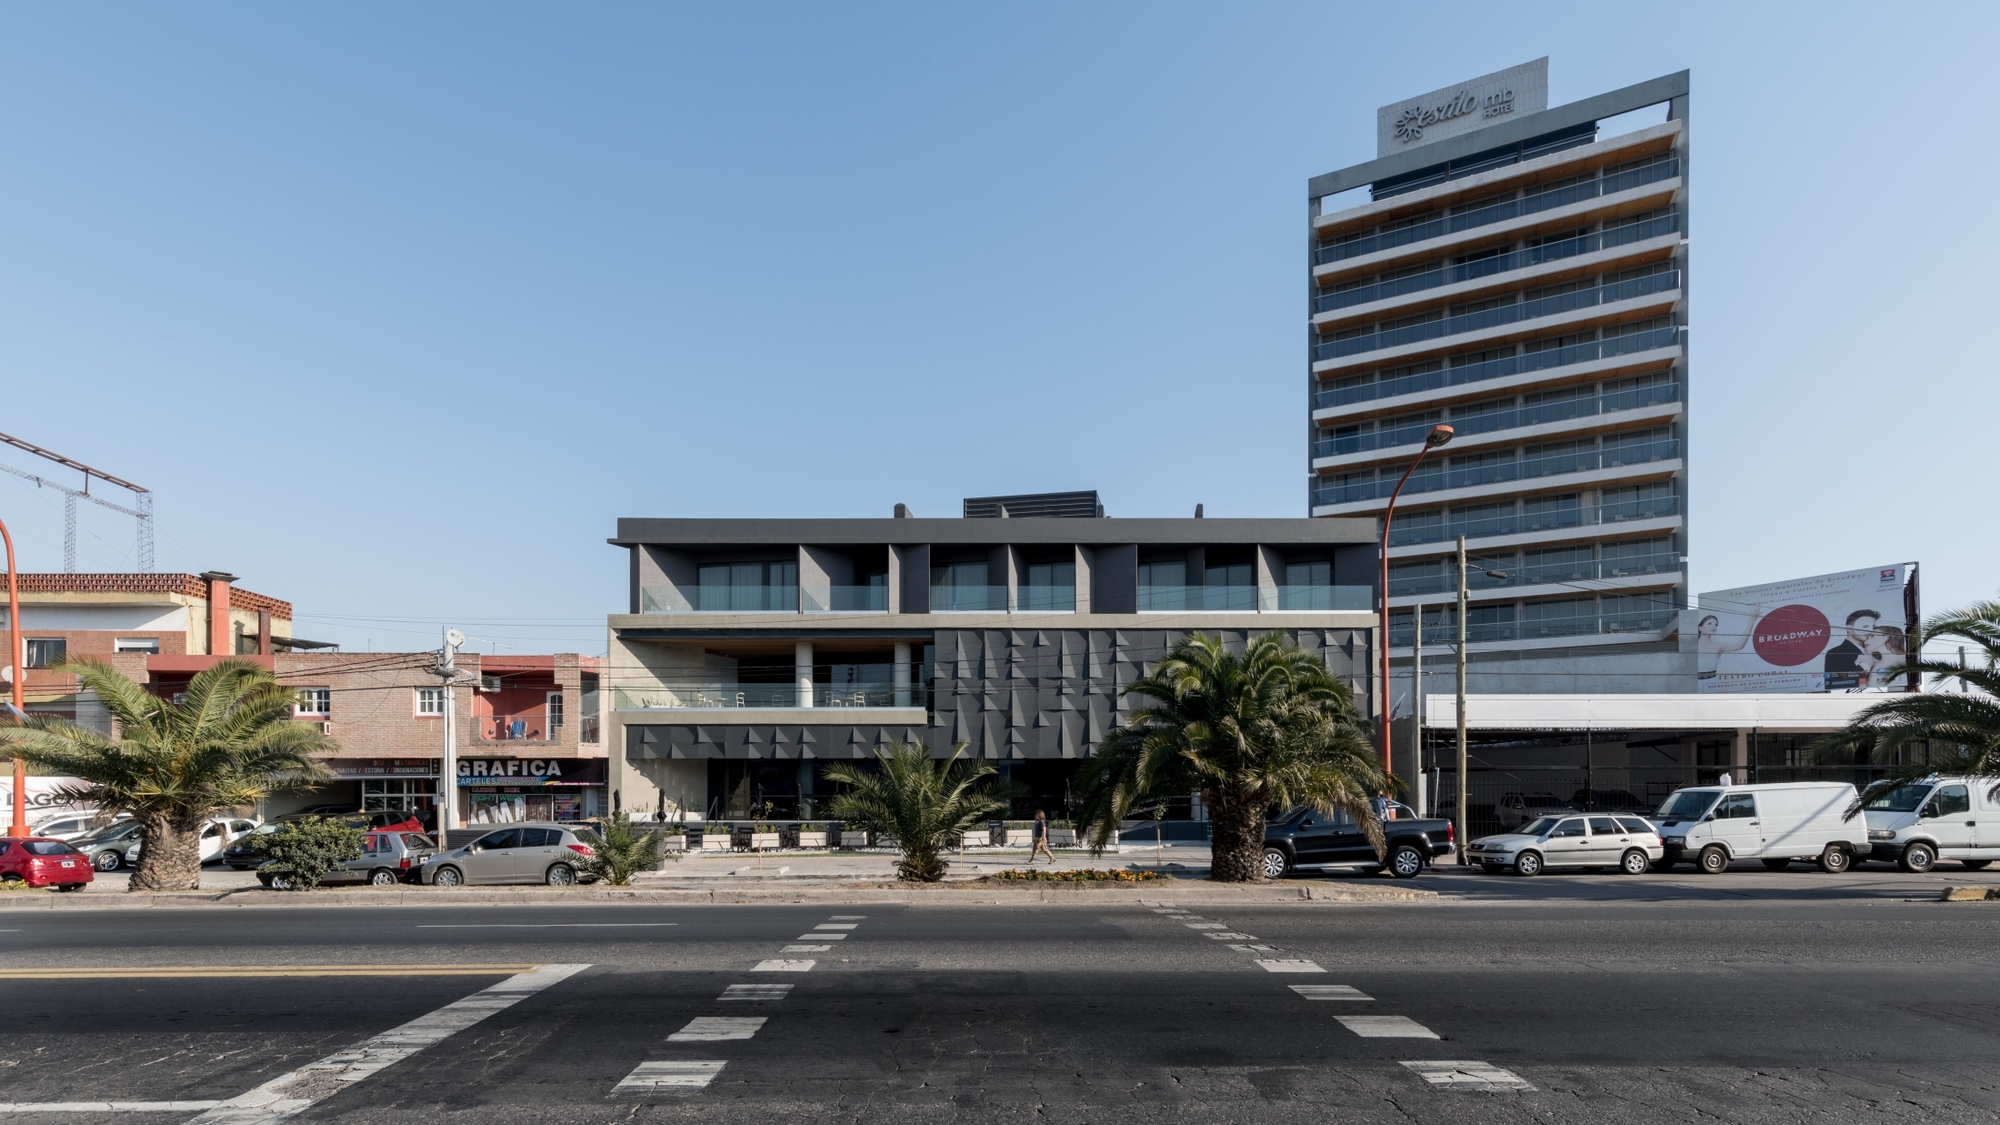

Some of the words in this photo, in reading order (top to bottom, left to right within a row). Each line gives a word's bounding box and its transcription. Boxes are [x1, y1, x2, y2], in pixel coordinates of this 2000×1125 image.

[1417, 90, 1478, 127] estilo
[1483, 103, 1515, 120] HOTEL
[1744, 587, 1772, 595] mejores
[1775, 580, 1812, 590] musicales
[1827, 573, 1867, 582] Broadway
[1792, 585, 1817, 593] Carlos
[1758, 629, 1823, 643] BROADWAY
[457, 760, 562, 776] GRAFICA
[457, 777, 497, 785] CARTELES
